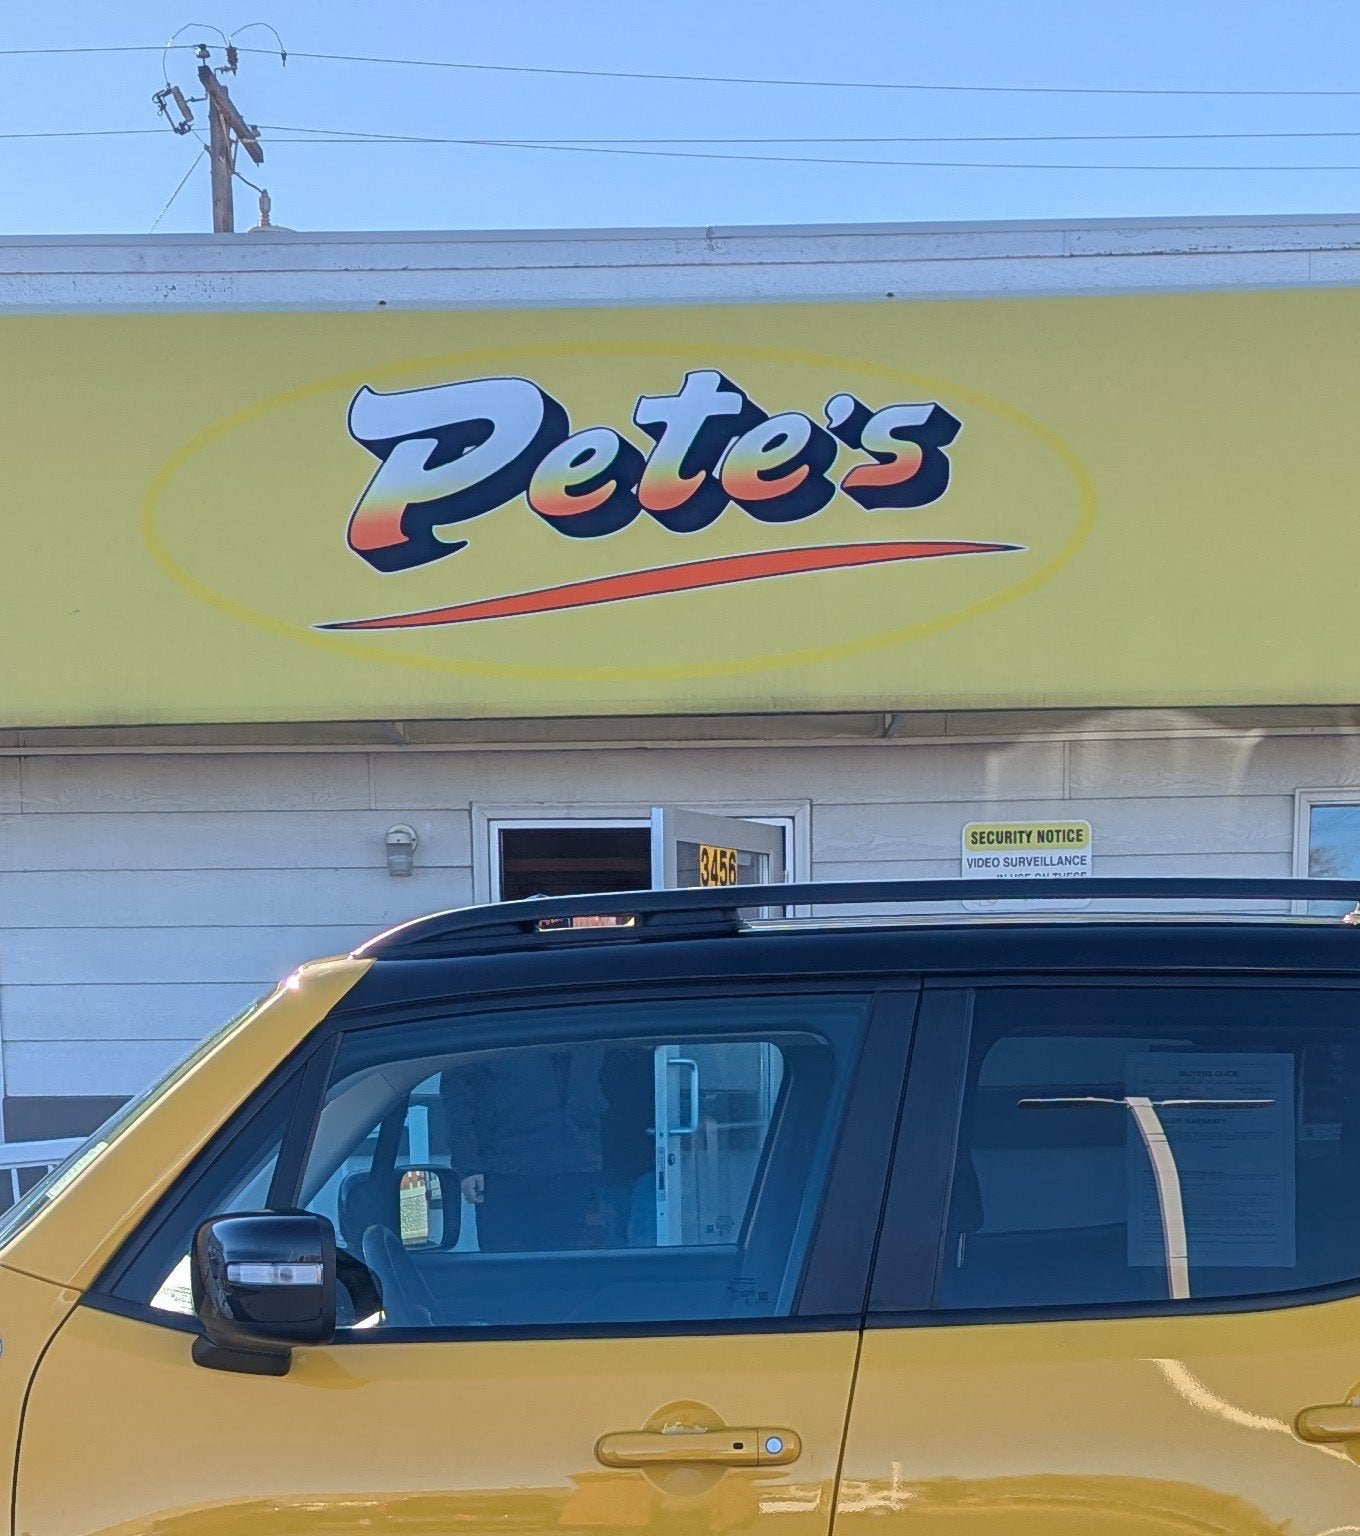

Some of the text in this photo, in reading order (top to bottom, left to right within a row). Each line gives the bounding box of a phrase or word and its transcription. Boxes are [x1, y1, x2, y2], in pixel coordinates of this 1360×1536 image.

[345, 368, 963, 573] Pete's
[970, 827, 1085, 846] SECURITY NOTICE
[700, 846, 737, 887] 3456
[966, 854, 1088, 870] VIDEO SURVEILLANCE
